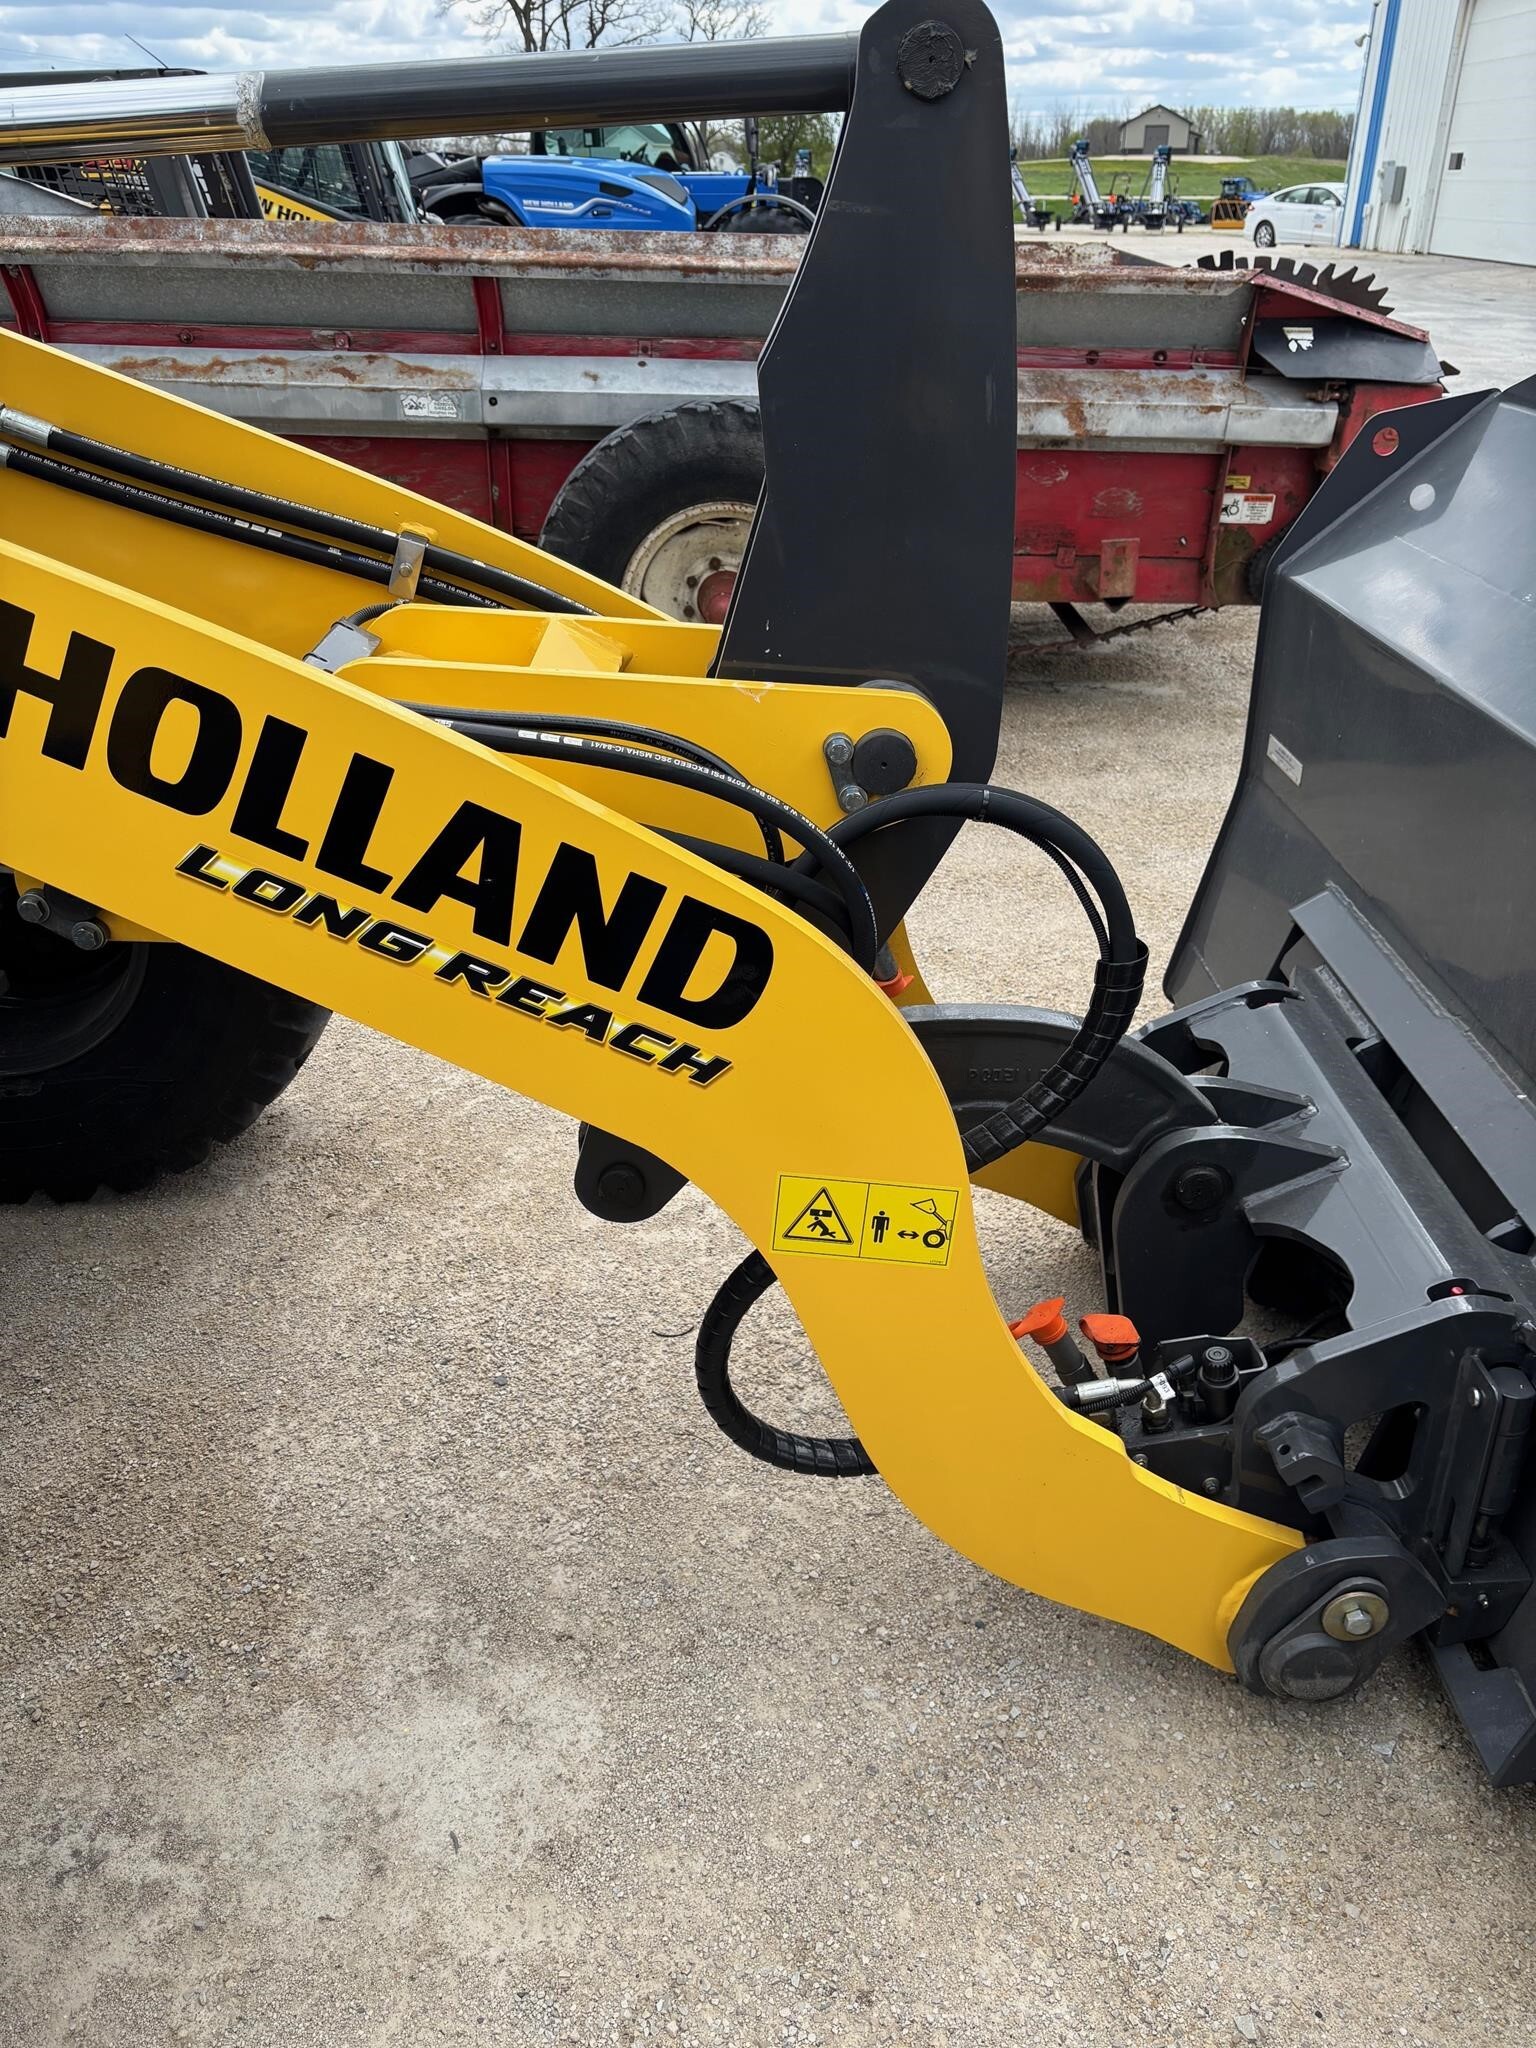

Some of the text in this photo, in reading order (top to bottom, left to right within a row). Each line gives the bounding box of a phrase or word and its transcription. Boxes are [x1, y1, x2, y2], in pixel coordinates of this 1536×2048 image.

[20, 449, 29, 458] 16
[29, 453, 42, 463] mm
[43, 458, 60, 469] Max.
[61, 464, 77, 475] W.P.
[78, 470, 91, 479] 300
[91, 474, 104, 482] Bar
[108, 481, 125, 491] 4350
[125, 485, 138, 494] PSI
[138, 490, 168, 504] EXCEED
[168, 499, 183, 508] 2SC
[183, 503, 204, 514] MSHA
[436, 581, 447, 589] DN
[448, 584, 456, 593] 16
[455, 588, 469, 597] mm
[469, 592, 484, 603] Max.
[590, 740, 624, 753] IC-84/41
[626, 747, 653, 760] MSHA
[654, 753, 672, 763] 2SC
[673, 758, 710, 774] EXCEED
[710, 769, 726, 780] PSI
[752, 786, 766, 798] Bar
[766, 794, 780, 805] 350
[0, 598, 774, 1030] HOLLAND
[782, 802, 798, 817] W.P.
[816, 827, 829, 840] mm
[828, 838, 838, 849] 12
[836, 846, 846, 859] DN
[175, 843, 733, 1085] LONG REACH
